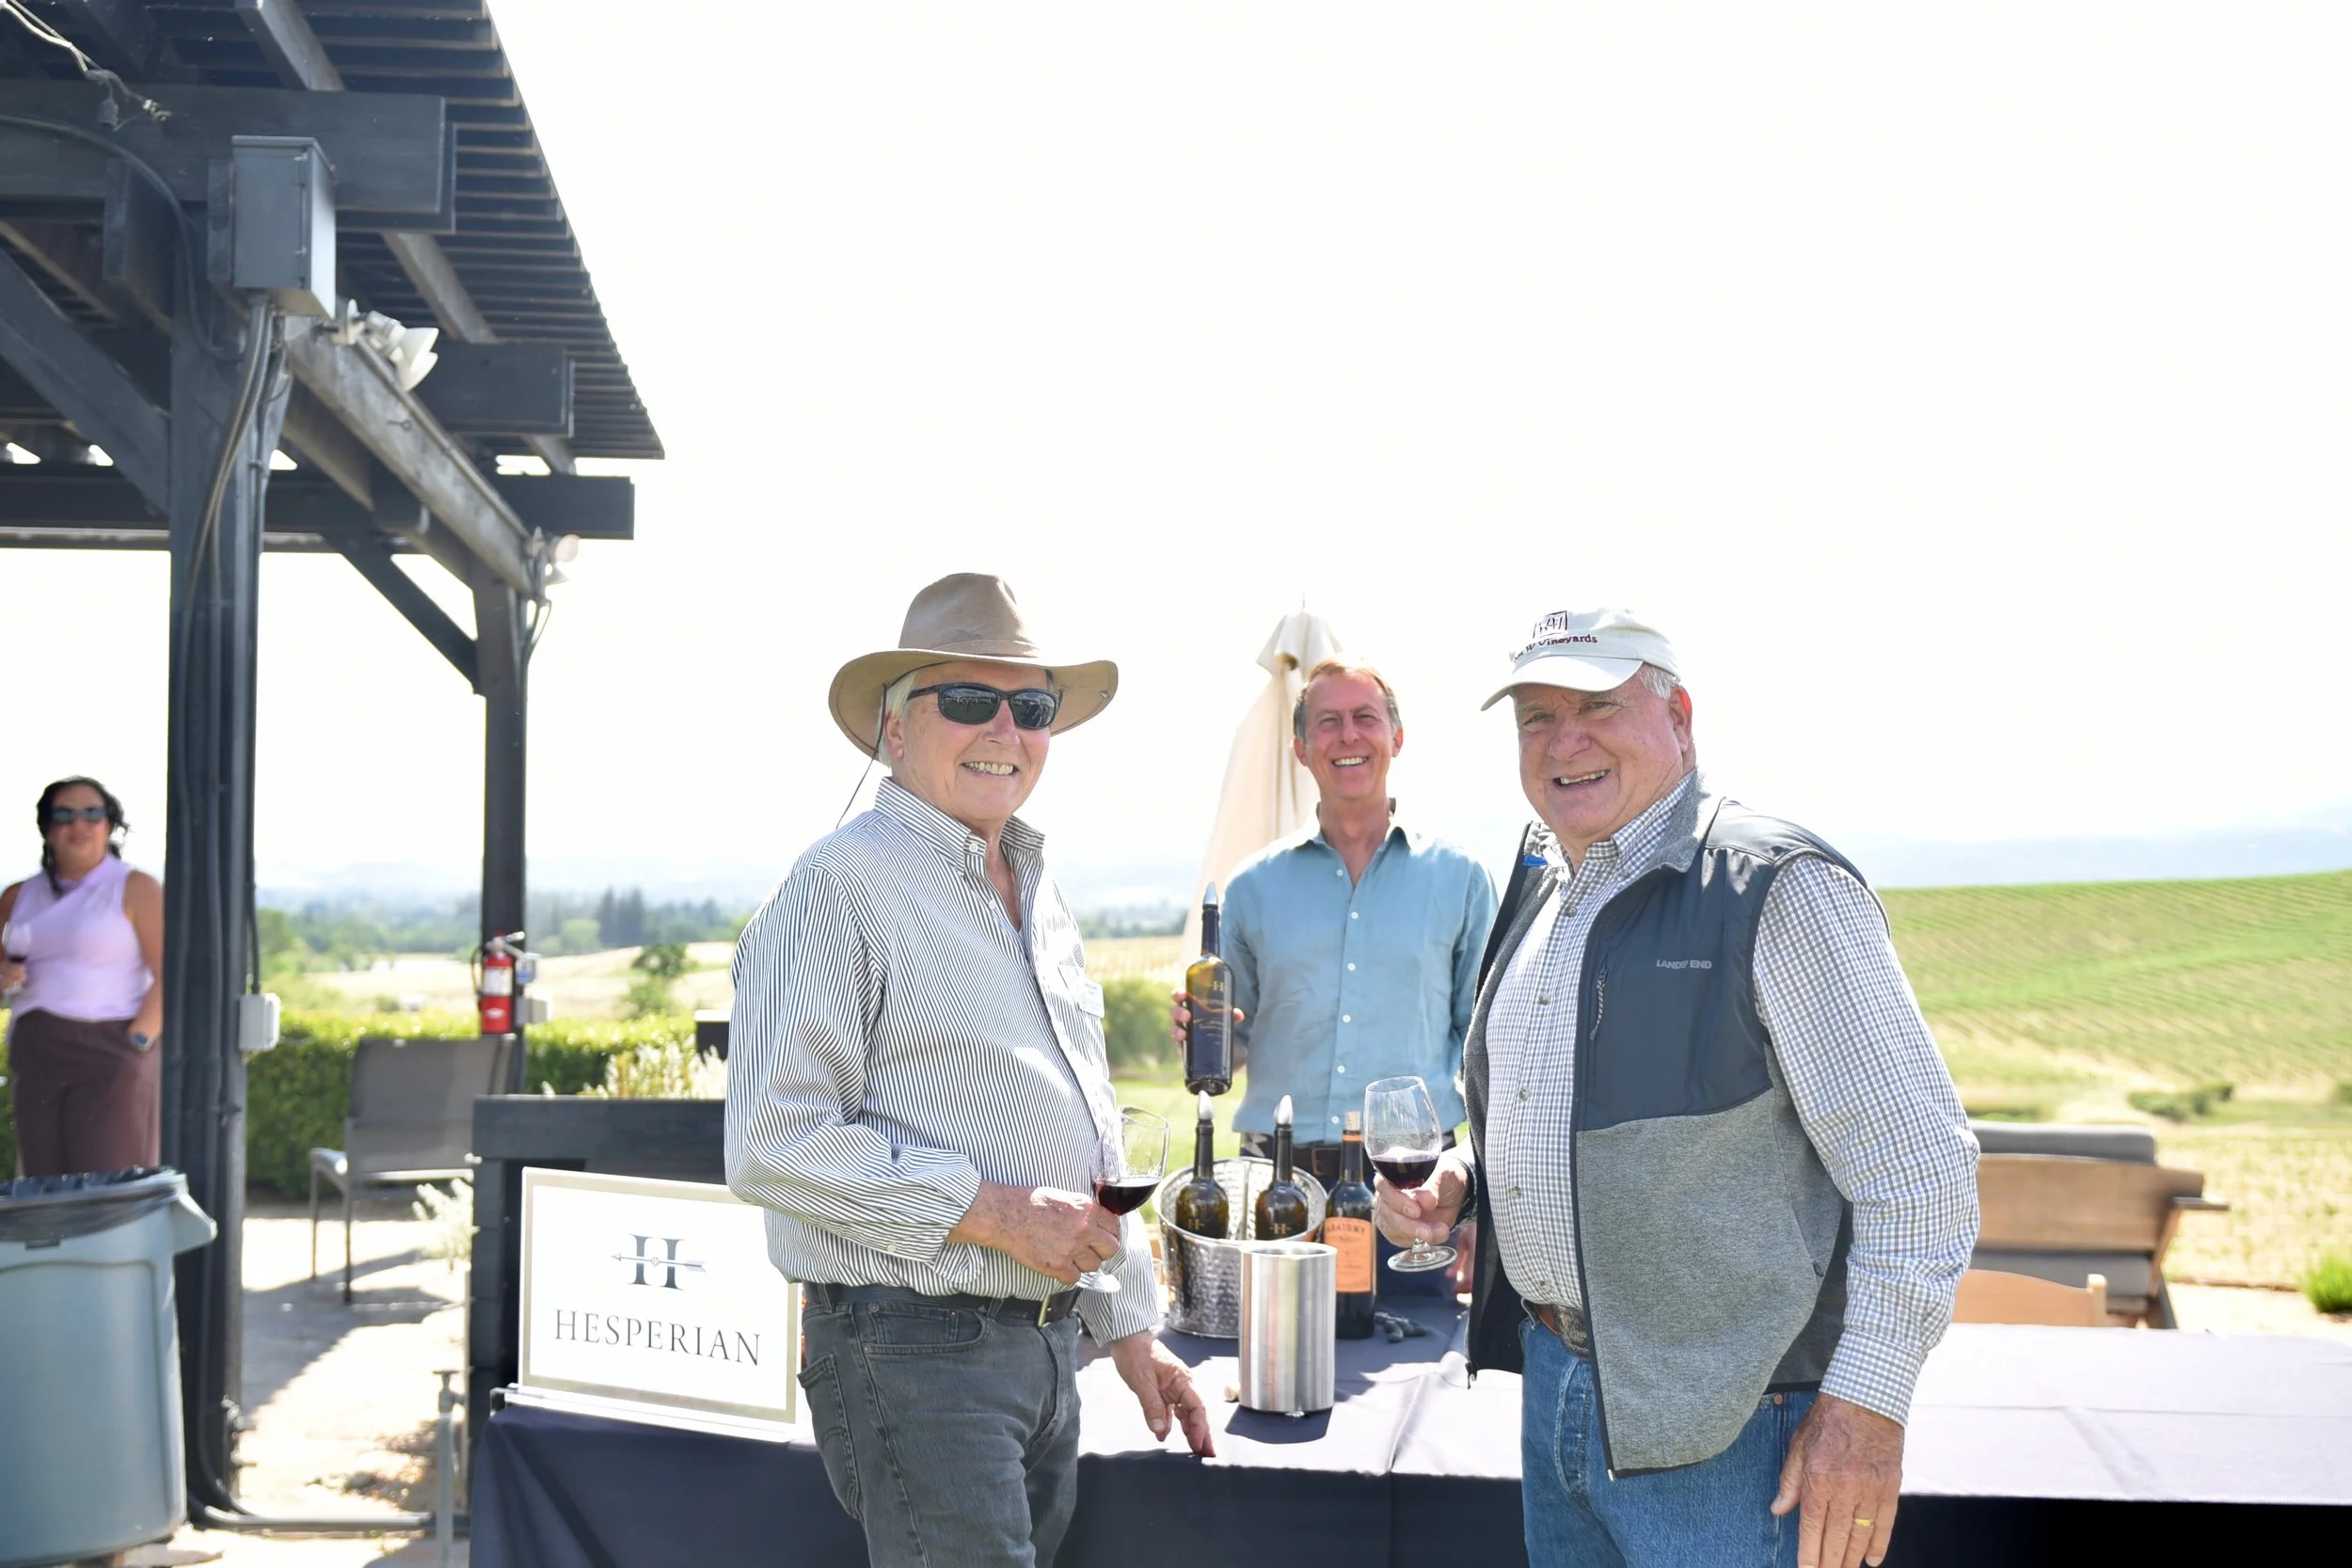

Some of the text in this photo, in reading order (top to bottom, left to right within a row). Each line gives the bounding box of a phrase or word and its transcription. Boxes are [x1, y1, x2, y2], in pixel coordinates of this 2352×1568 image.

[1538, 634, 1598, 646] Vineyards
[1690, 959, 1712, 970] END
[627, 1233, 686, 1291] H
[554, 1308, 761, 1367] HESPERIAN
